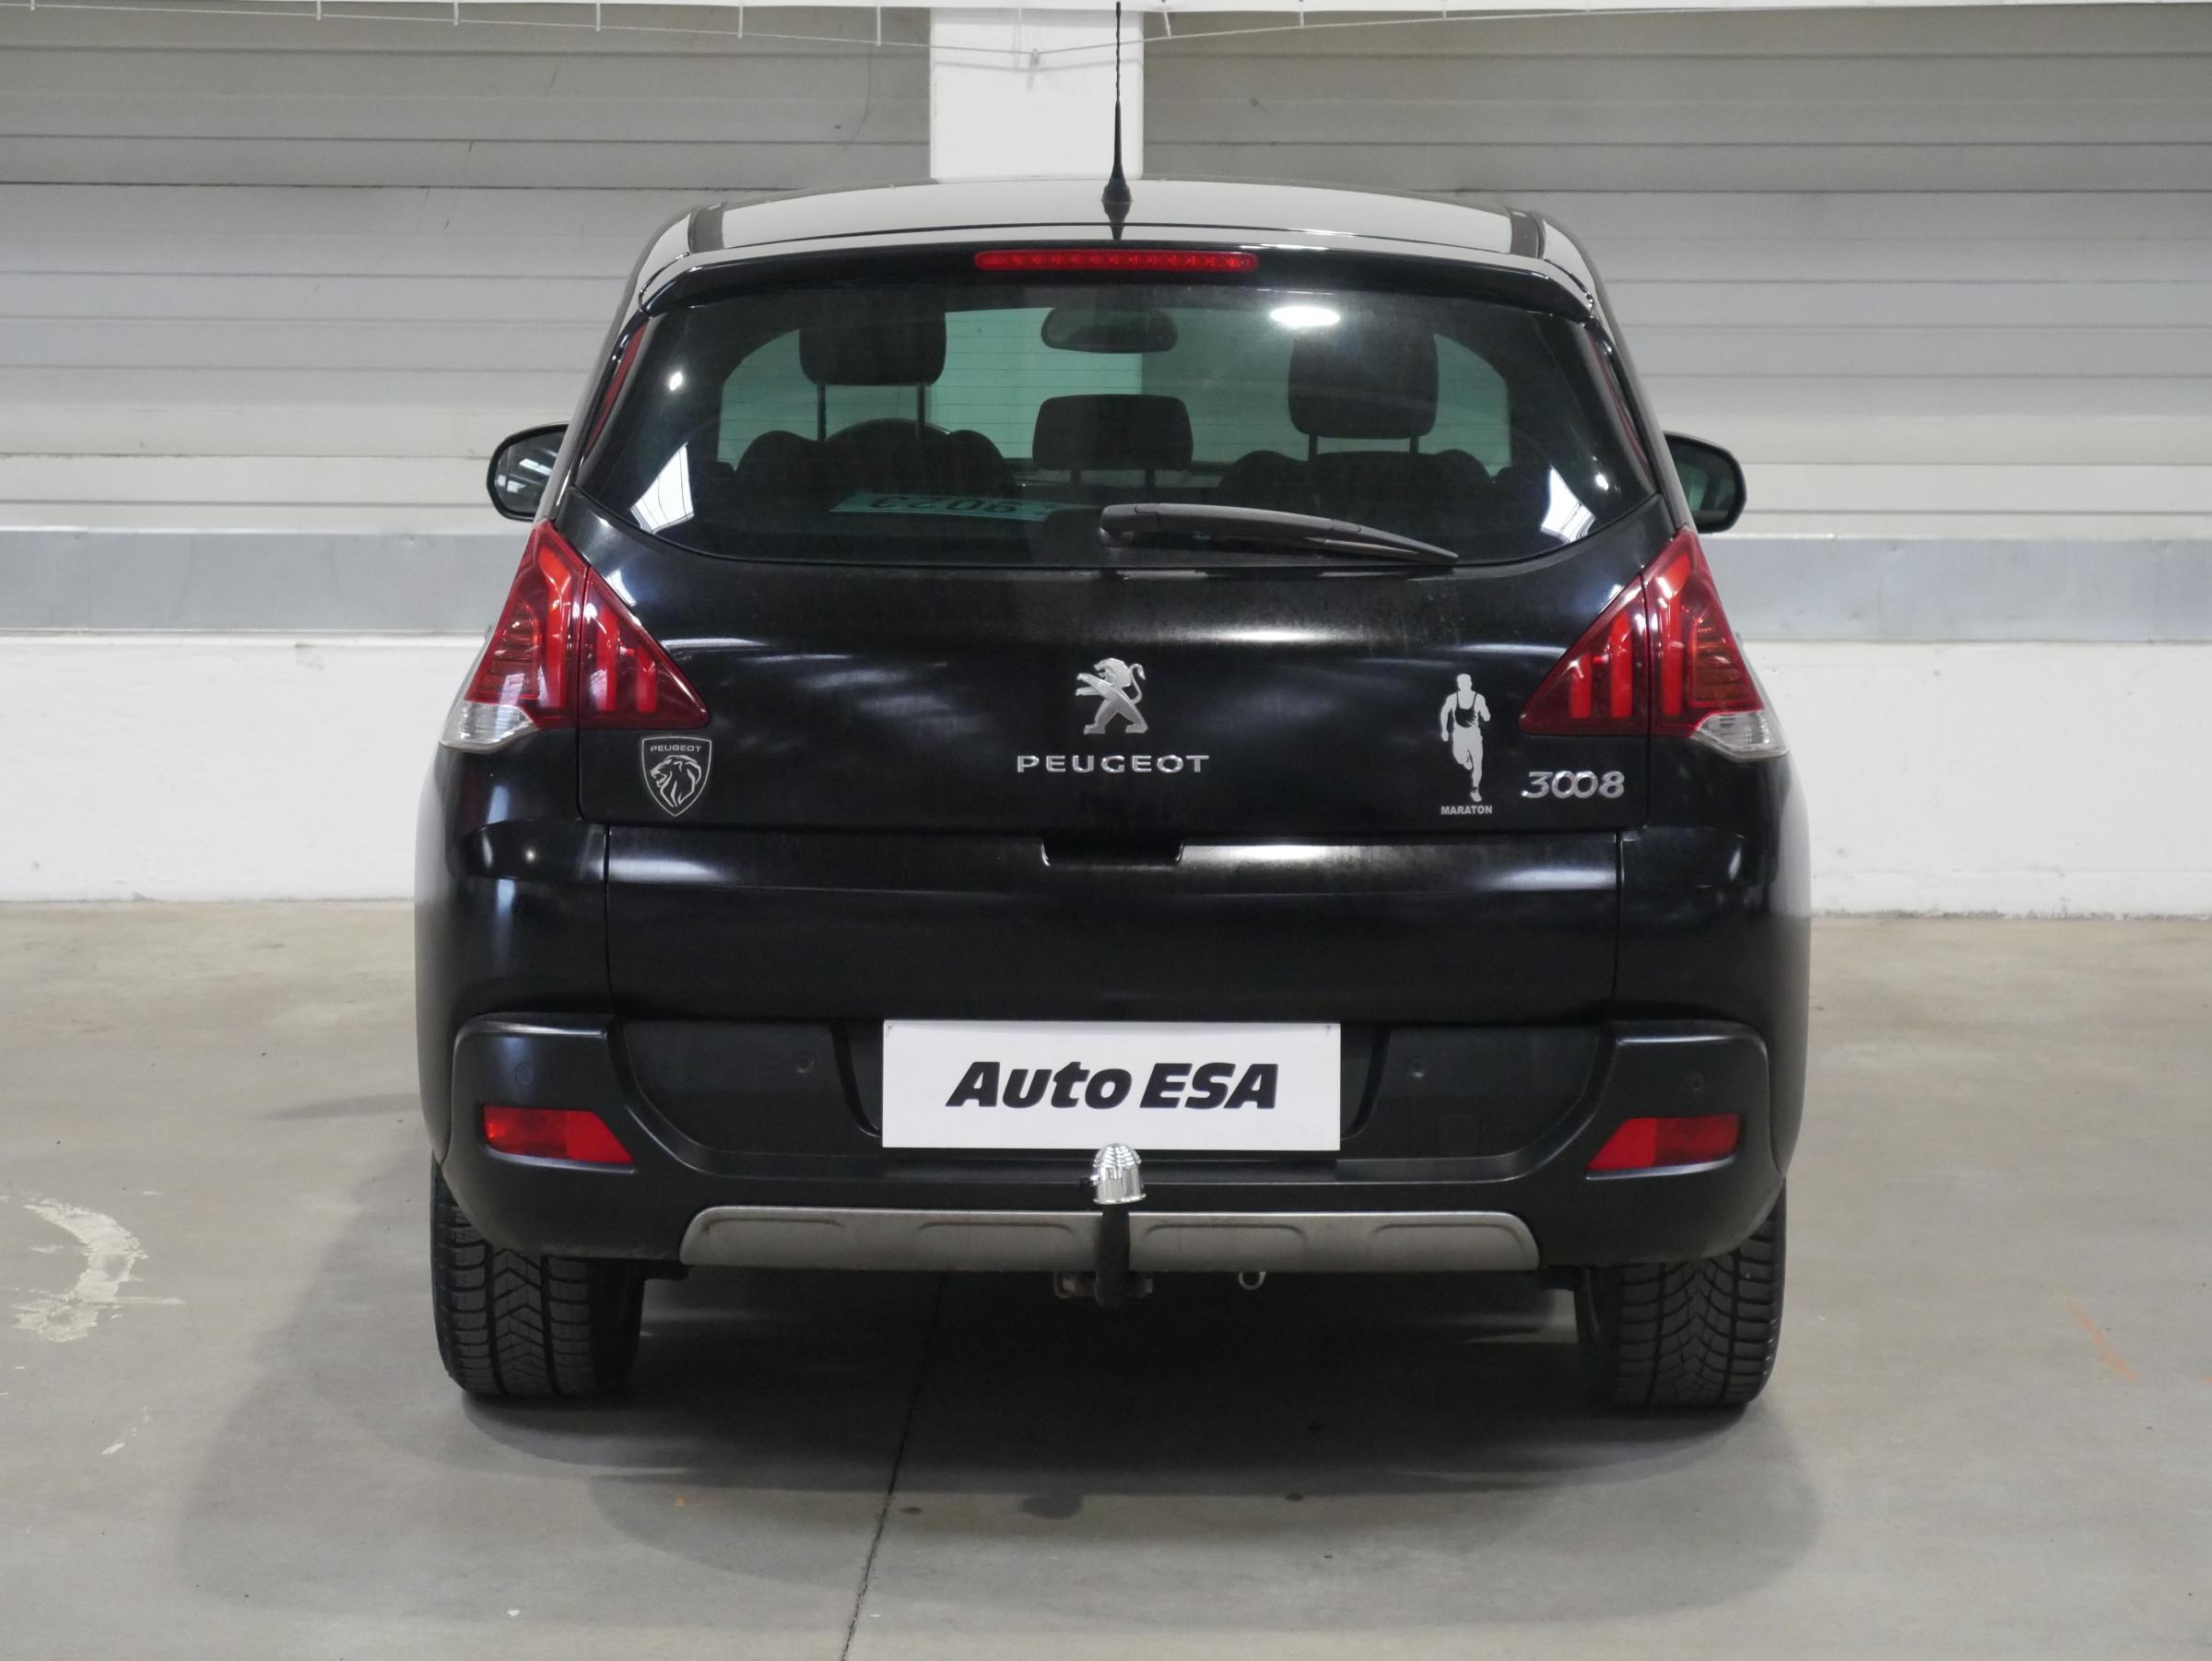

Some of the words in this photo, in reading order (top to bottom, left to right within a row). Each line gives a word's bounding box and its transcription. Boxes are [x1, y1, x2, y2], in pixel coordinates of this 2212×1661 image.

[650, 744, 702, 753] PEUGEOT
[1017, 754, 1210, 773] PEUGEOT
[1521, 770, 1626, 799] 3008
[1441, 805, 1493, 815] MARATON
[945, 1061, 1133, 1110] Auto
[1139, 1062, 1279, 1110] ESA
